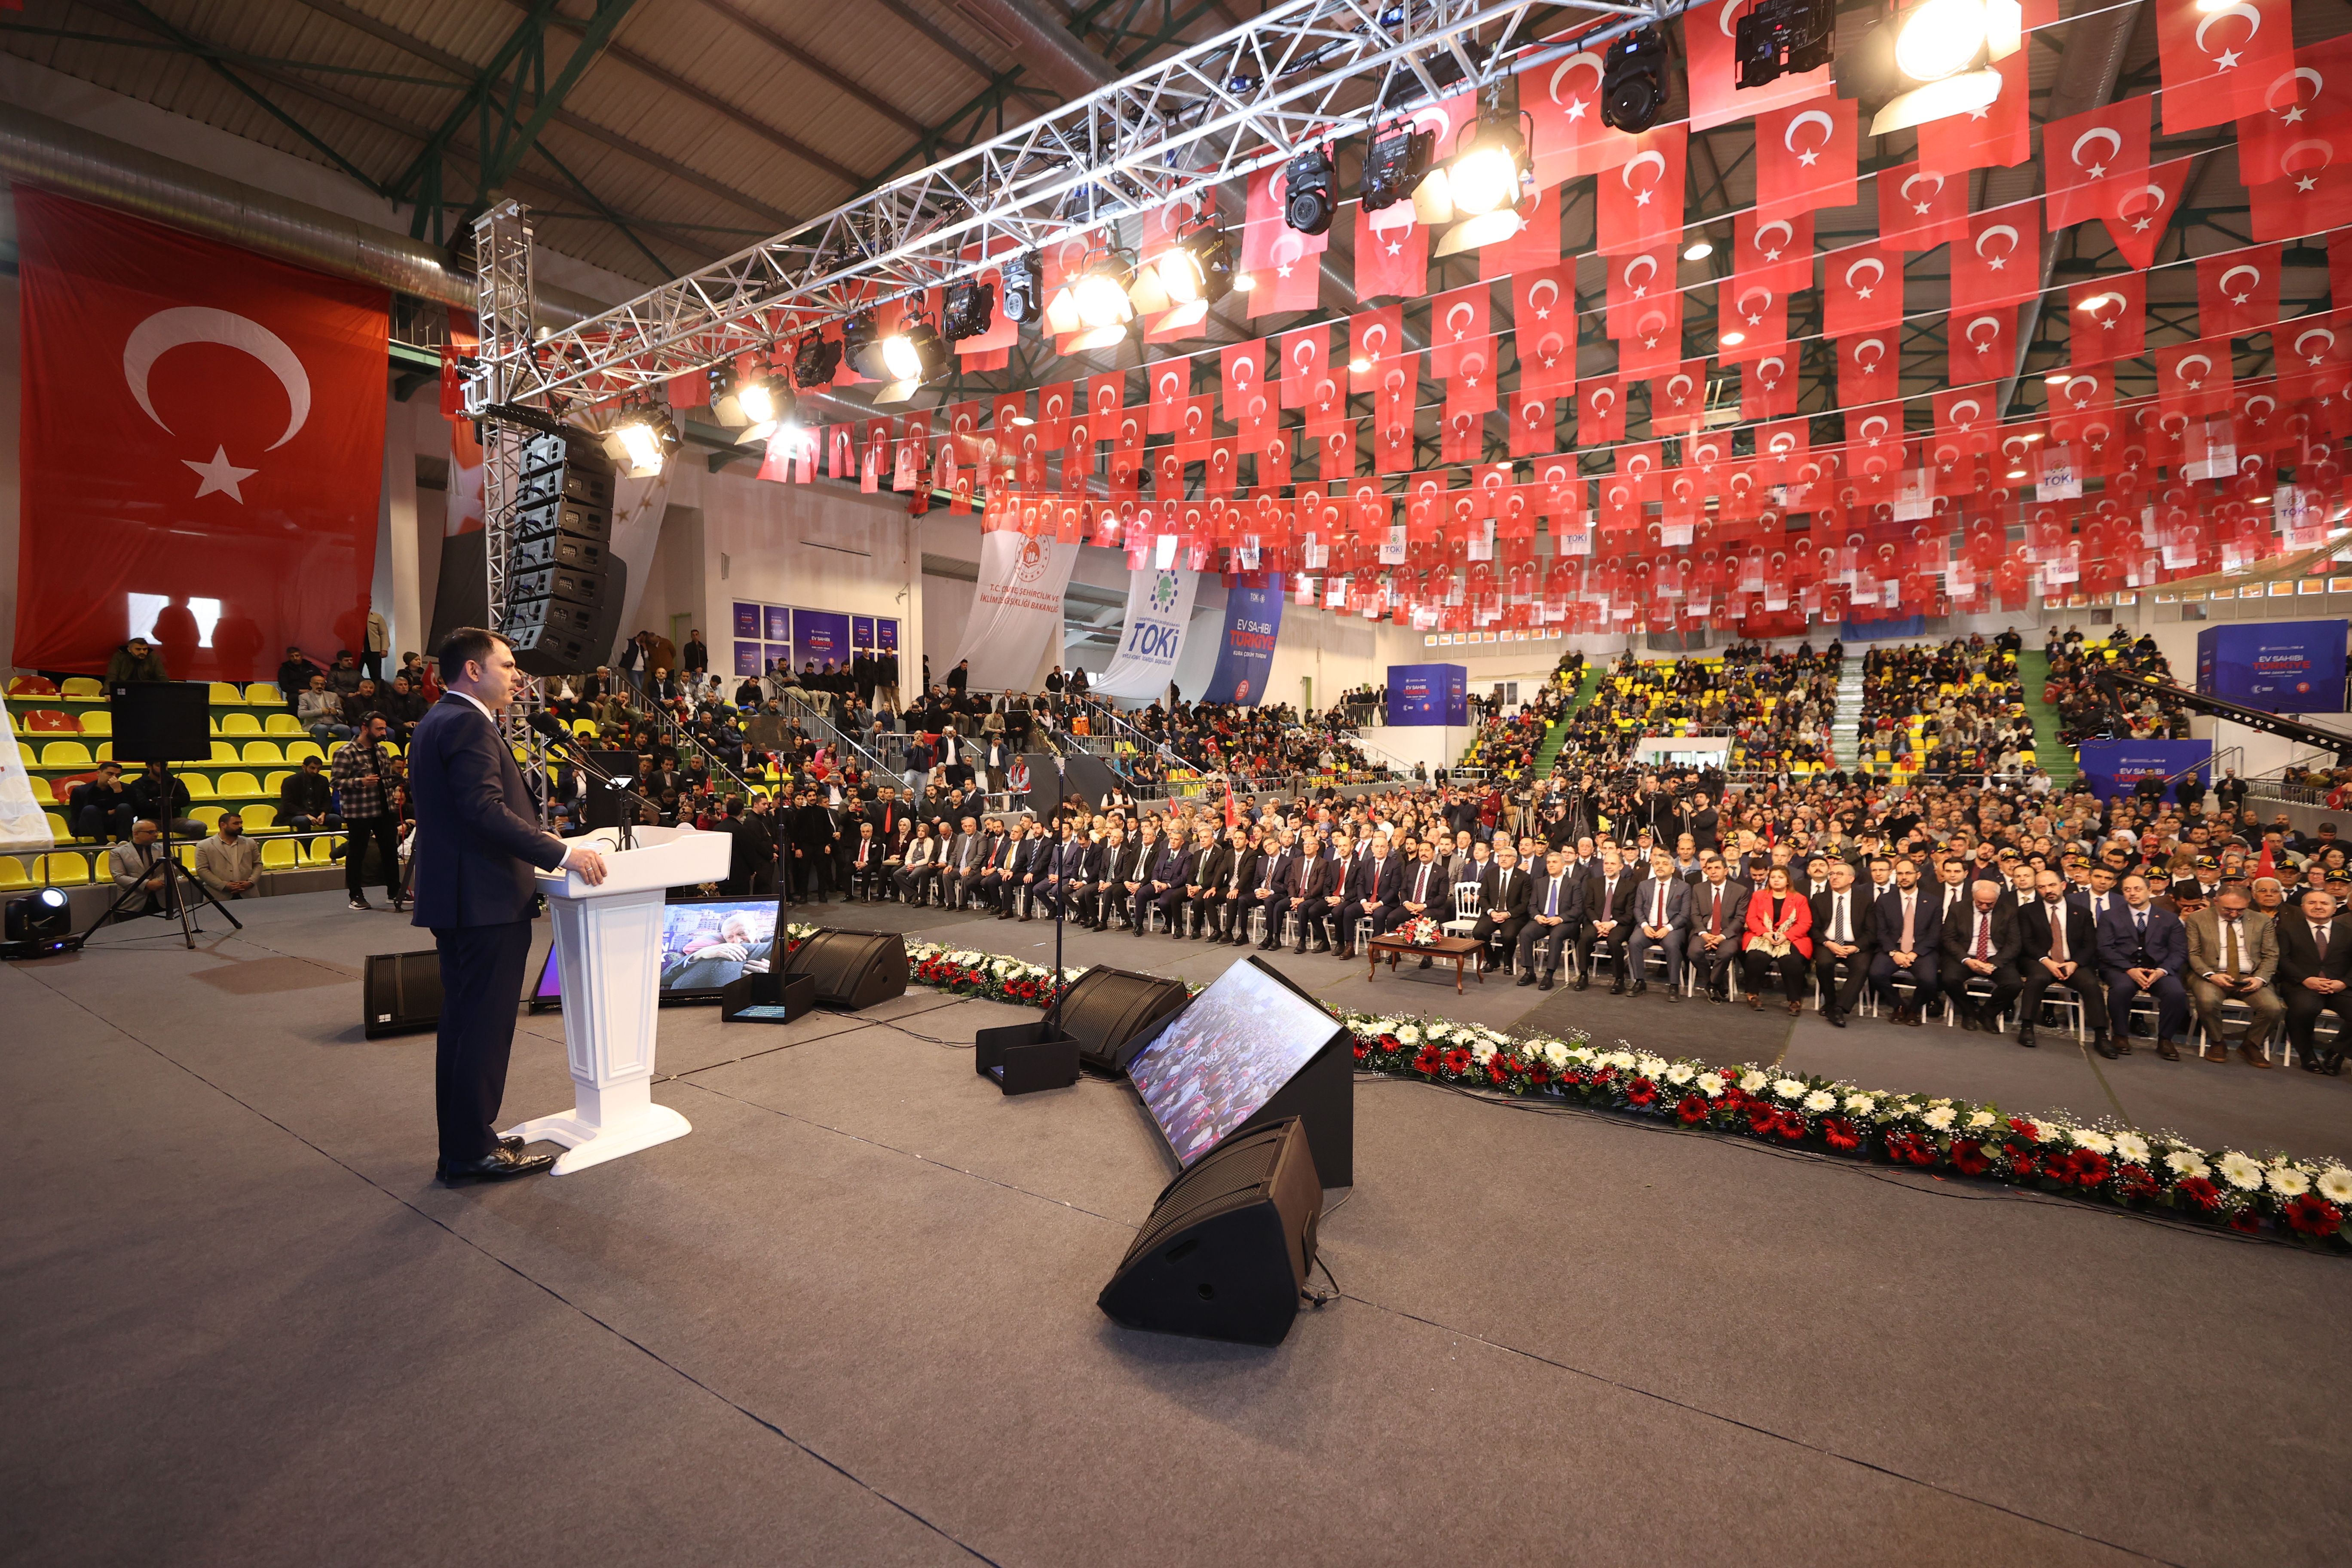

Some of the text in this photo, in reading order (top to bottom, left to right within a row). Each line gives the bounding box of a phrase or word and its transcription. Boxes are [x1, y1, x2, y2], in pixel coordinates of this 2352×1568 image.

[1019, 588, 1051, 600] ŞEHİRCİLİK
[980, 593, 997, 603] İKLİM
[1031, 602, 1059, 612] BAKANLIĞ
[1237, 619, 1247, 630] EV
[1128, 623, 1179, 658] TOKİ
